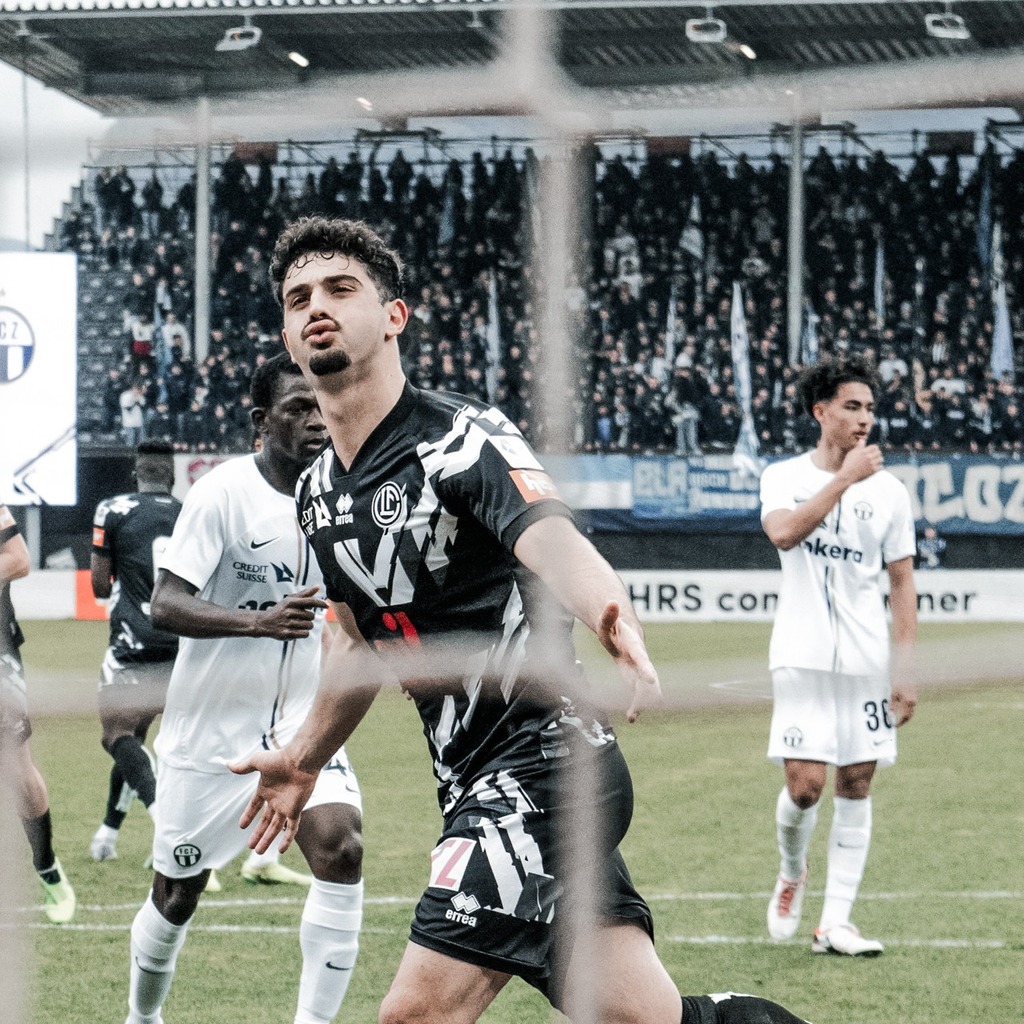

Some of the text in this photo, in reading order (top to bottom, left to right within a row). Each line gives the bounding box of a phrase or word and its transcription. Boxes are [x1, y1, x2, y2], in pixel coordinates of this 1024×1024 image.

[232, 561, 269, 574] CREDIT
[236, 571, 267, 583] SUISSE
[629, 584, 702, 612] HRS
[445, 909, 478, 928] errea
